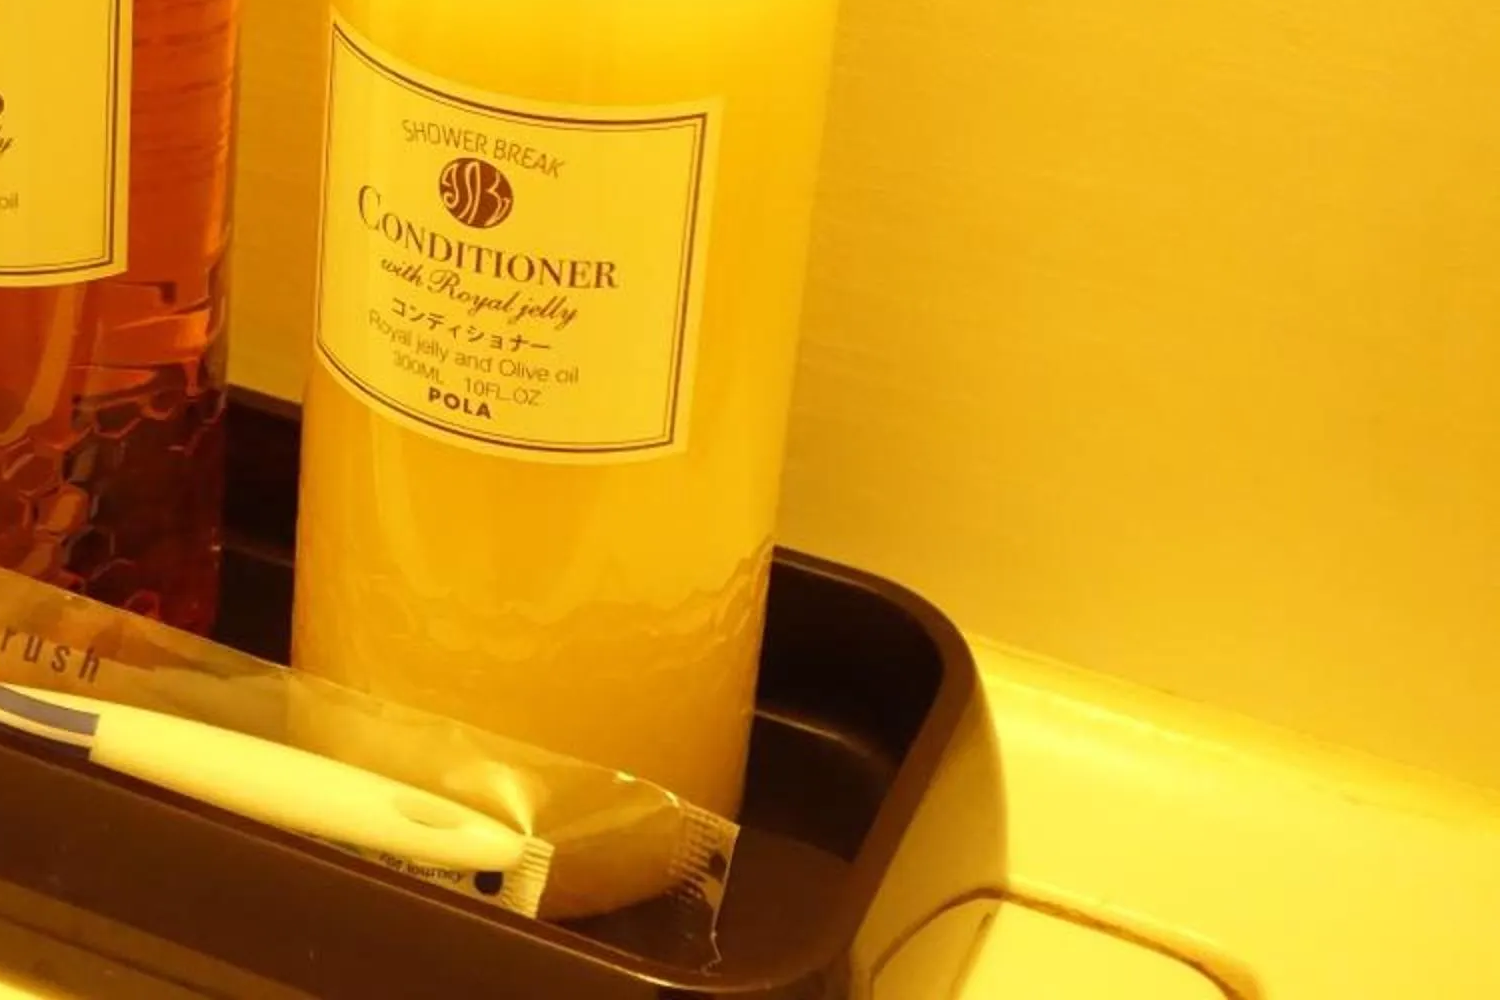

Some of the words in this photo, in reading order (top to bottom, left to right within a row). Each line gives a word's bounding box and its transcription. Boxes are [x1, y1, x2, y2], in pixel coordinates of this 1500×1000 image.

[401, 119, 488, 155] SHOWER
[493, 137, 566, 179] BREAK
[358, 184, 620, 289] CONDITIONER
[380, 258, 423, 287] with
[427, 269, 521, 317] Royal
[507, 296, 578, 331] jelly
[391, 297, 552, 352] コンディショナー
[368, 308, 411, 347] Royal
[416, 335, 449, 363] jelly
[455, 352, 493, 374] and
[499, 359, 549, 383] Olive
[555, 366, 580, 385] oil
[428, 386, 492, 420] POLA
